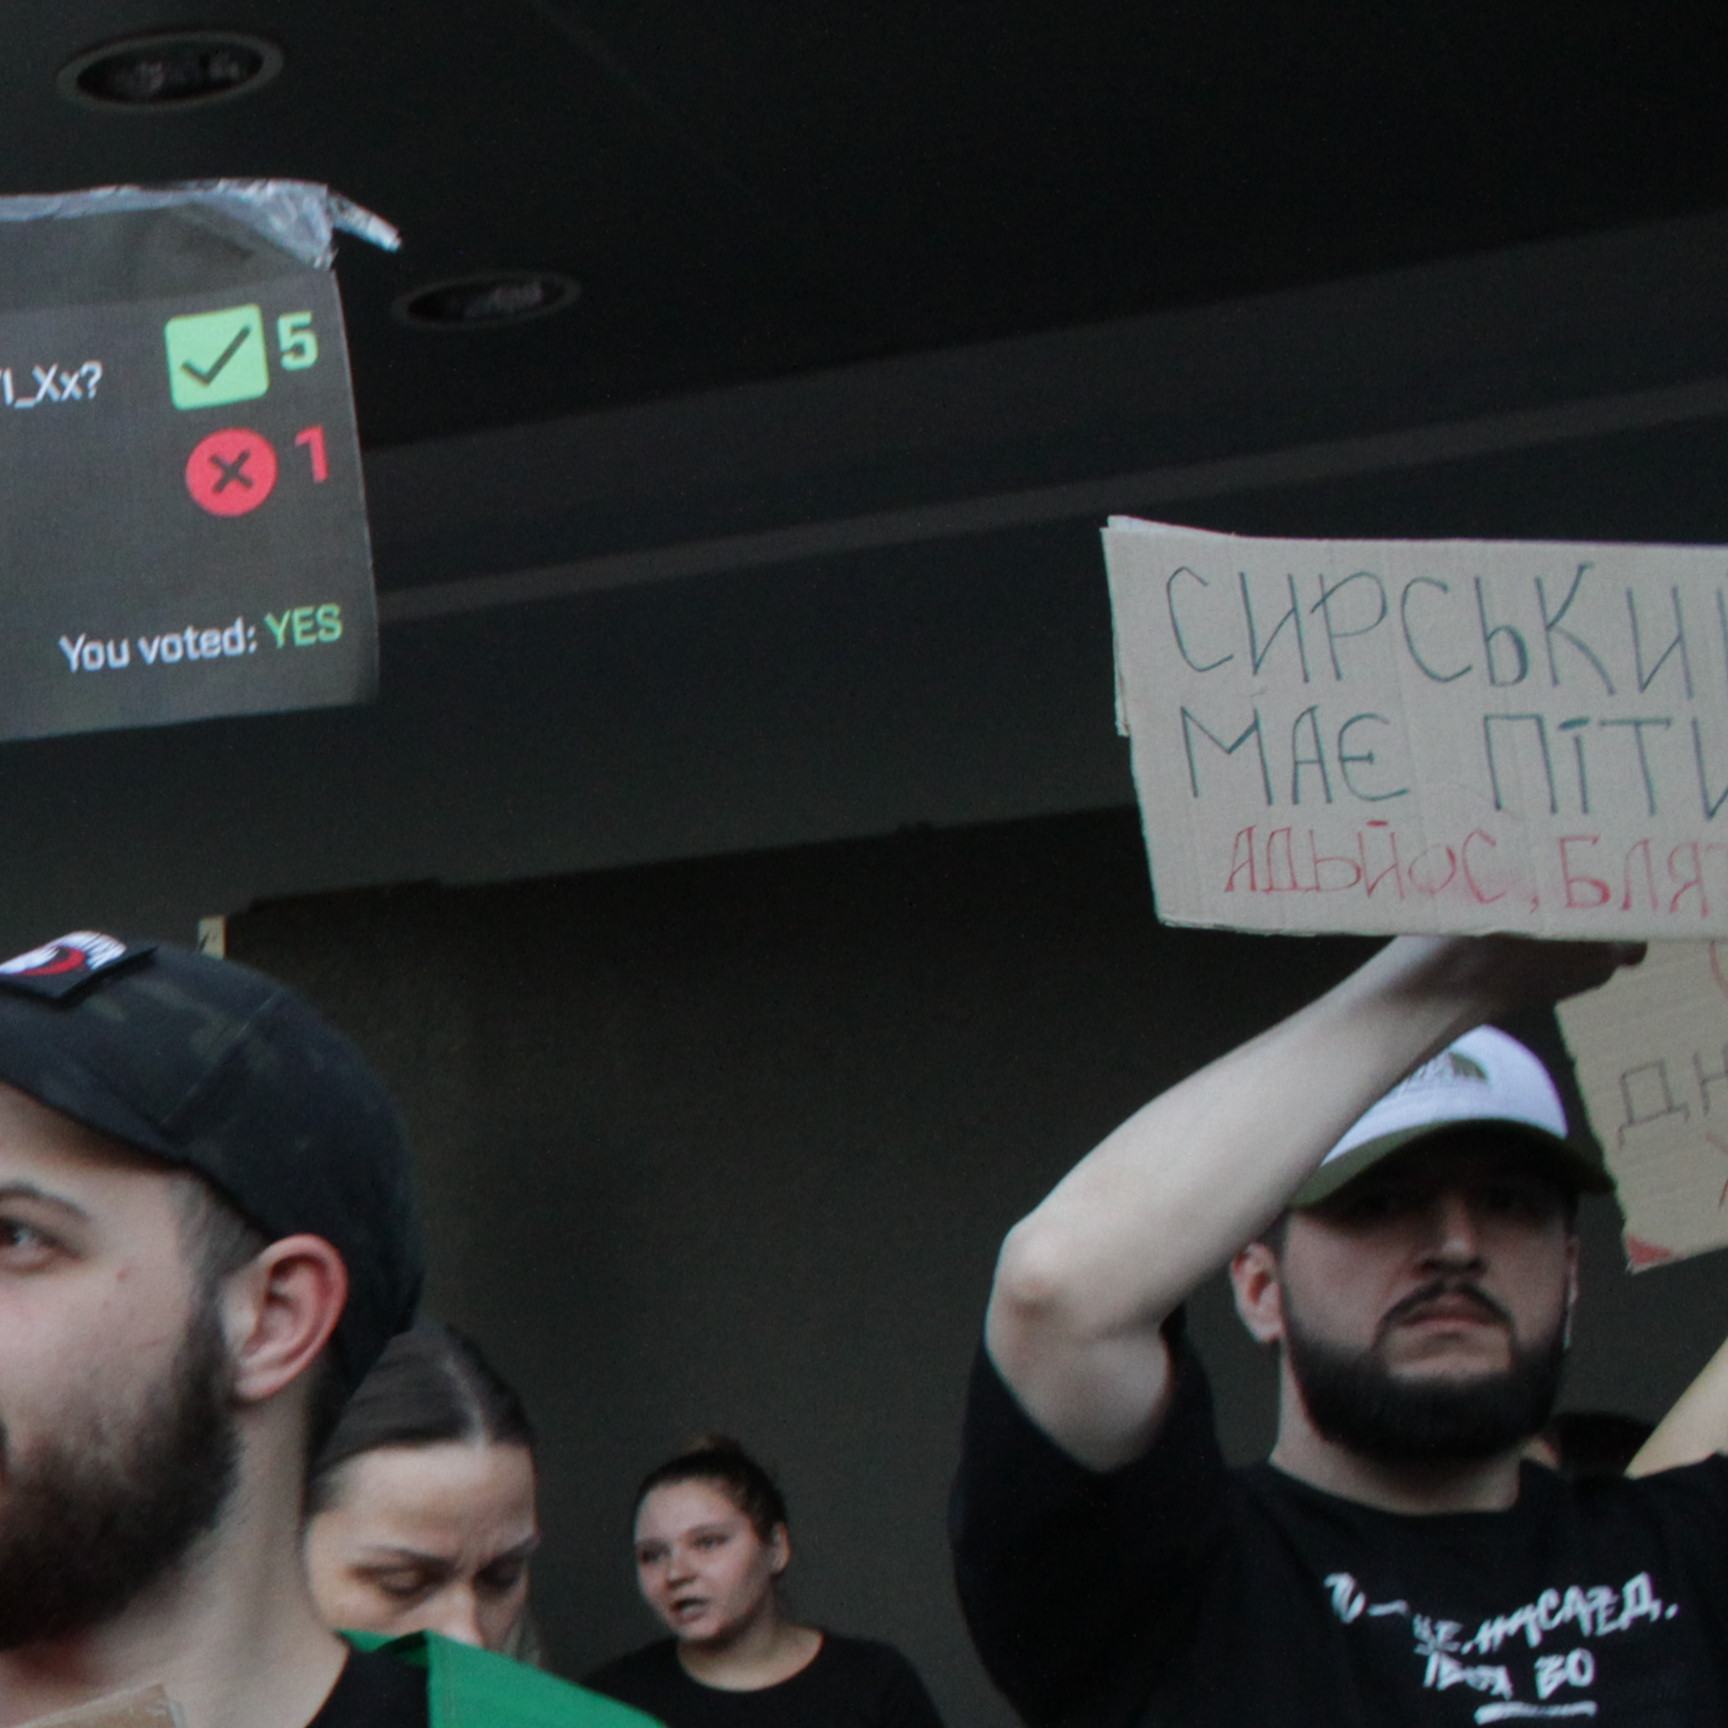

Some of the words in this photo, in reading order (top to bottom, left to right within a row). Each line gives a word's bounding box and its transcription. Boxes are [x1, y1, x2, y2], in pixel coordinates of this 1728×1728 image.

[276, 312, 319, 371] 5
[295, 426, 329, 485] 1
[59, 634, 130, 674] You
[138, 622, 257, 664] voted:
[264, 604, 343, 649] YES
[1165, 562, 1728, 700] СИРСЬКИ
[1179, 704, 1410, 808] МАЄ
[1557, 835, 1728, 919] БЛЯ
